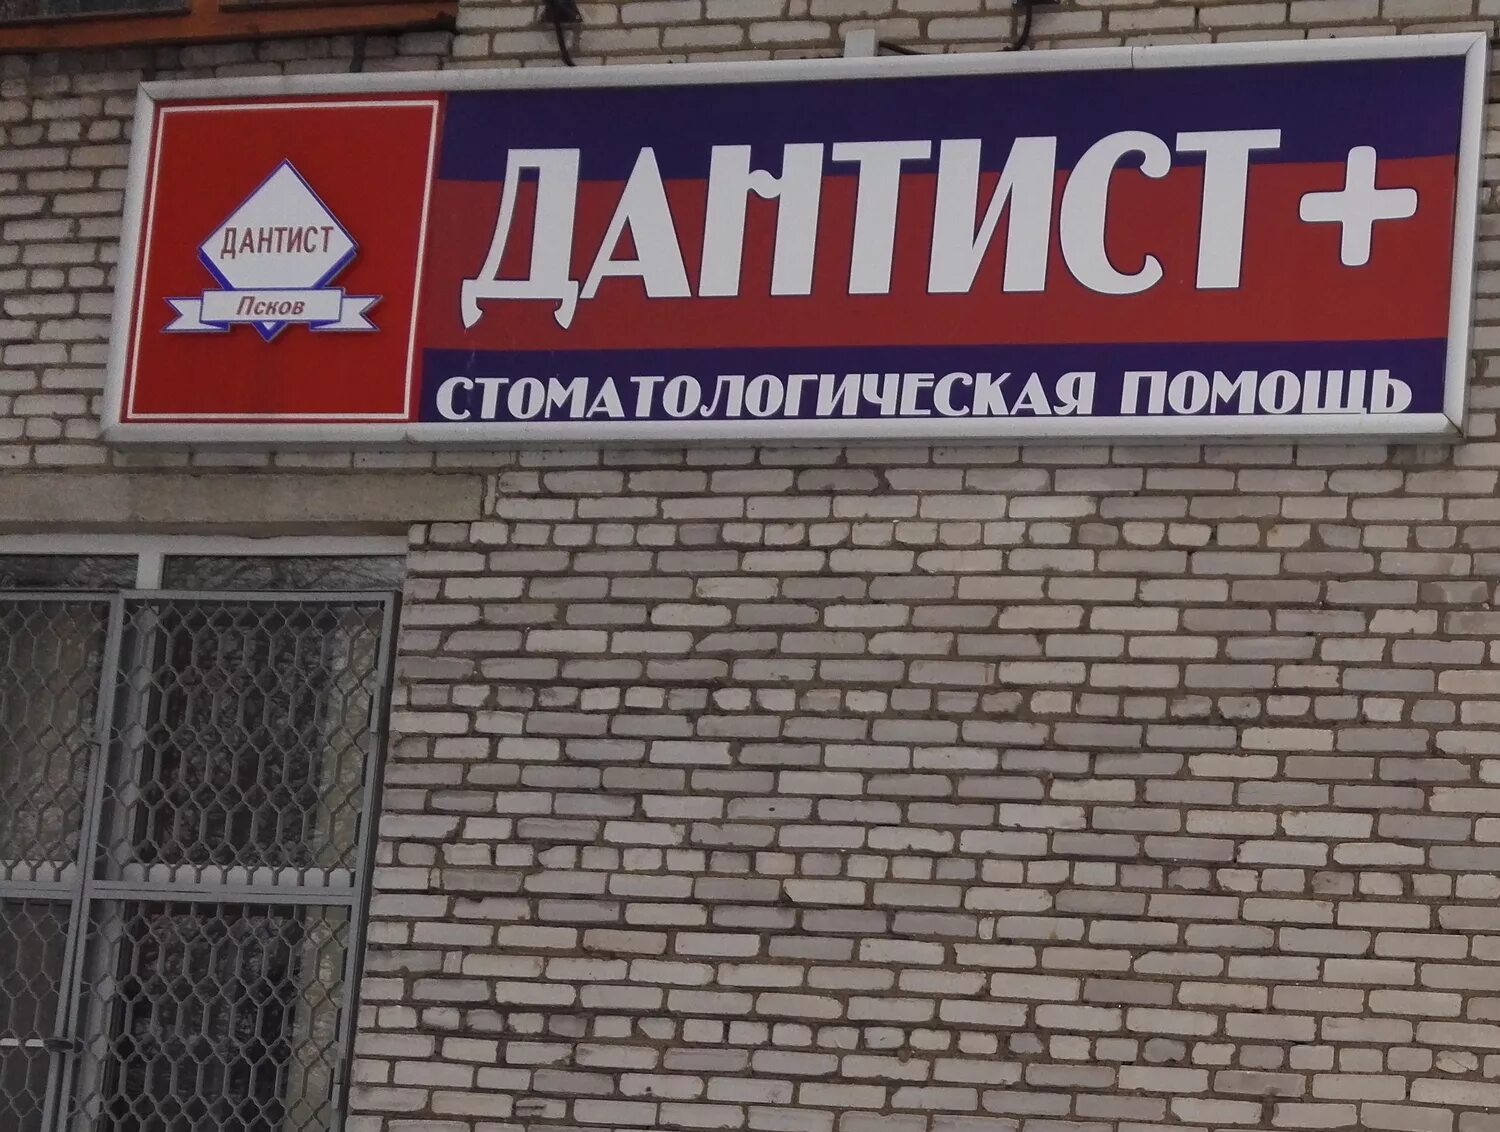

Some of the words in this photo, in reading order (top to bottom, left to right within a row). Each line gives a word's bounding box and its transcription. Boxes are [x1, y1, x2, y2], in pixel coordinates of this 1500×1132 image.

[220, 226, 334, 259] ДАНТИСТ
[460, 128, 1282, 329] ДАНТИСТ
[236, 296, 306, 316] Псков
[435, 371, 1096, 421] СТОМАТОЛОГИЧЕСКАЯ
[1119, 368, 1413, 416] ПОМОЩЬ
